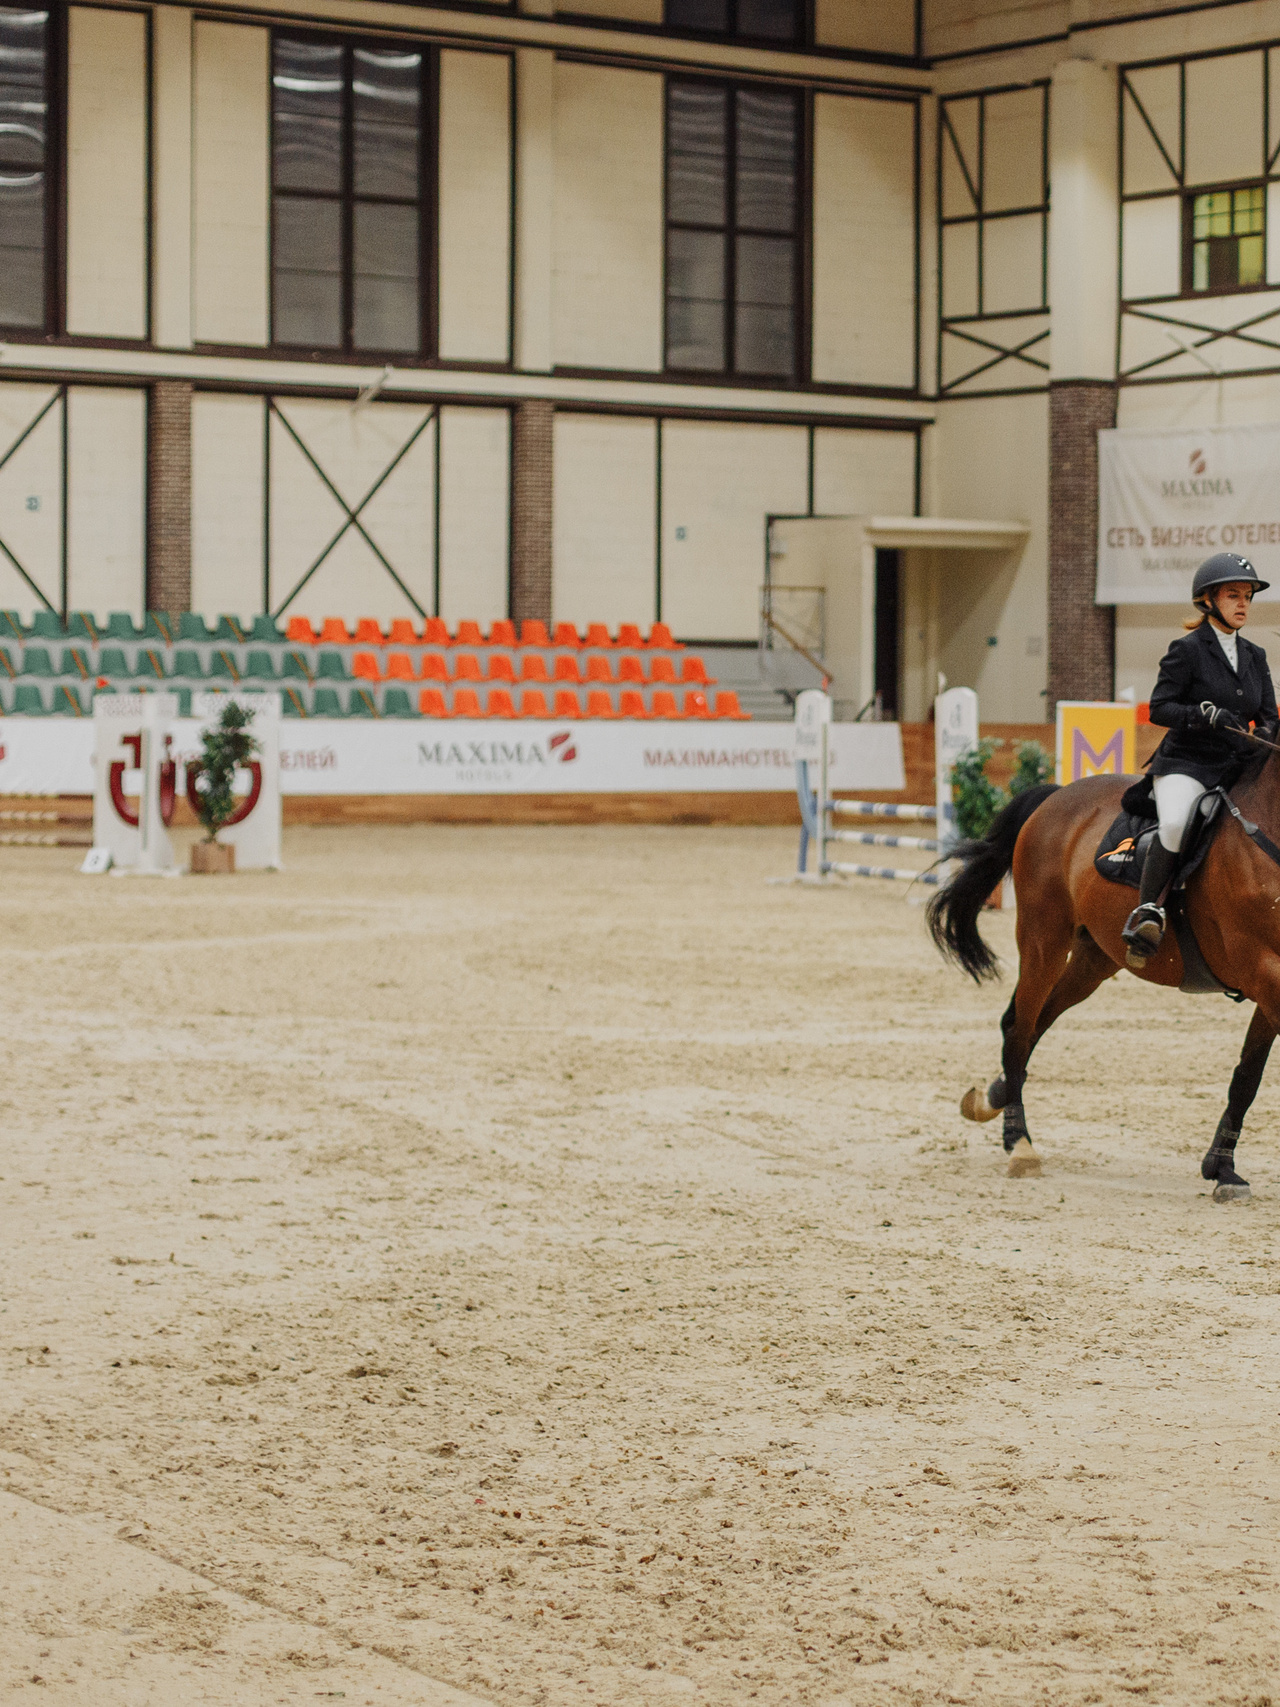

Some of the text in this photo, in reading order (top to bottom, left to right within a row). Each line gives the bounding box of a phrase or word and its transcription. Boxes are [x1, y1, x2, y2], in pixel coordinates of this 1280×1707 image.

[1106, 526, 1145, 549] СЕТЬ
[1151, 524, 1217, 547] БИЗНЕС
[418, 741, 546, 766] MAXIMA
